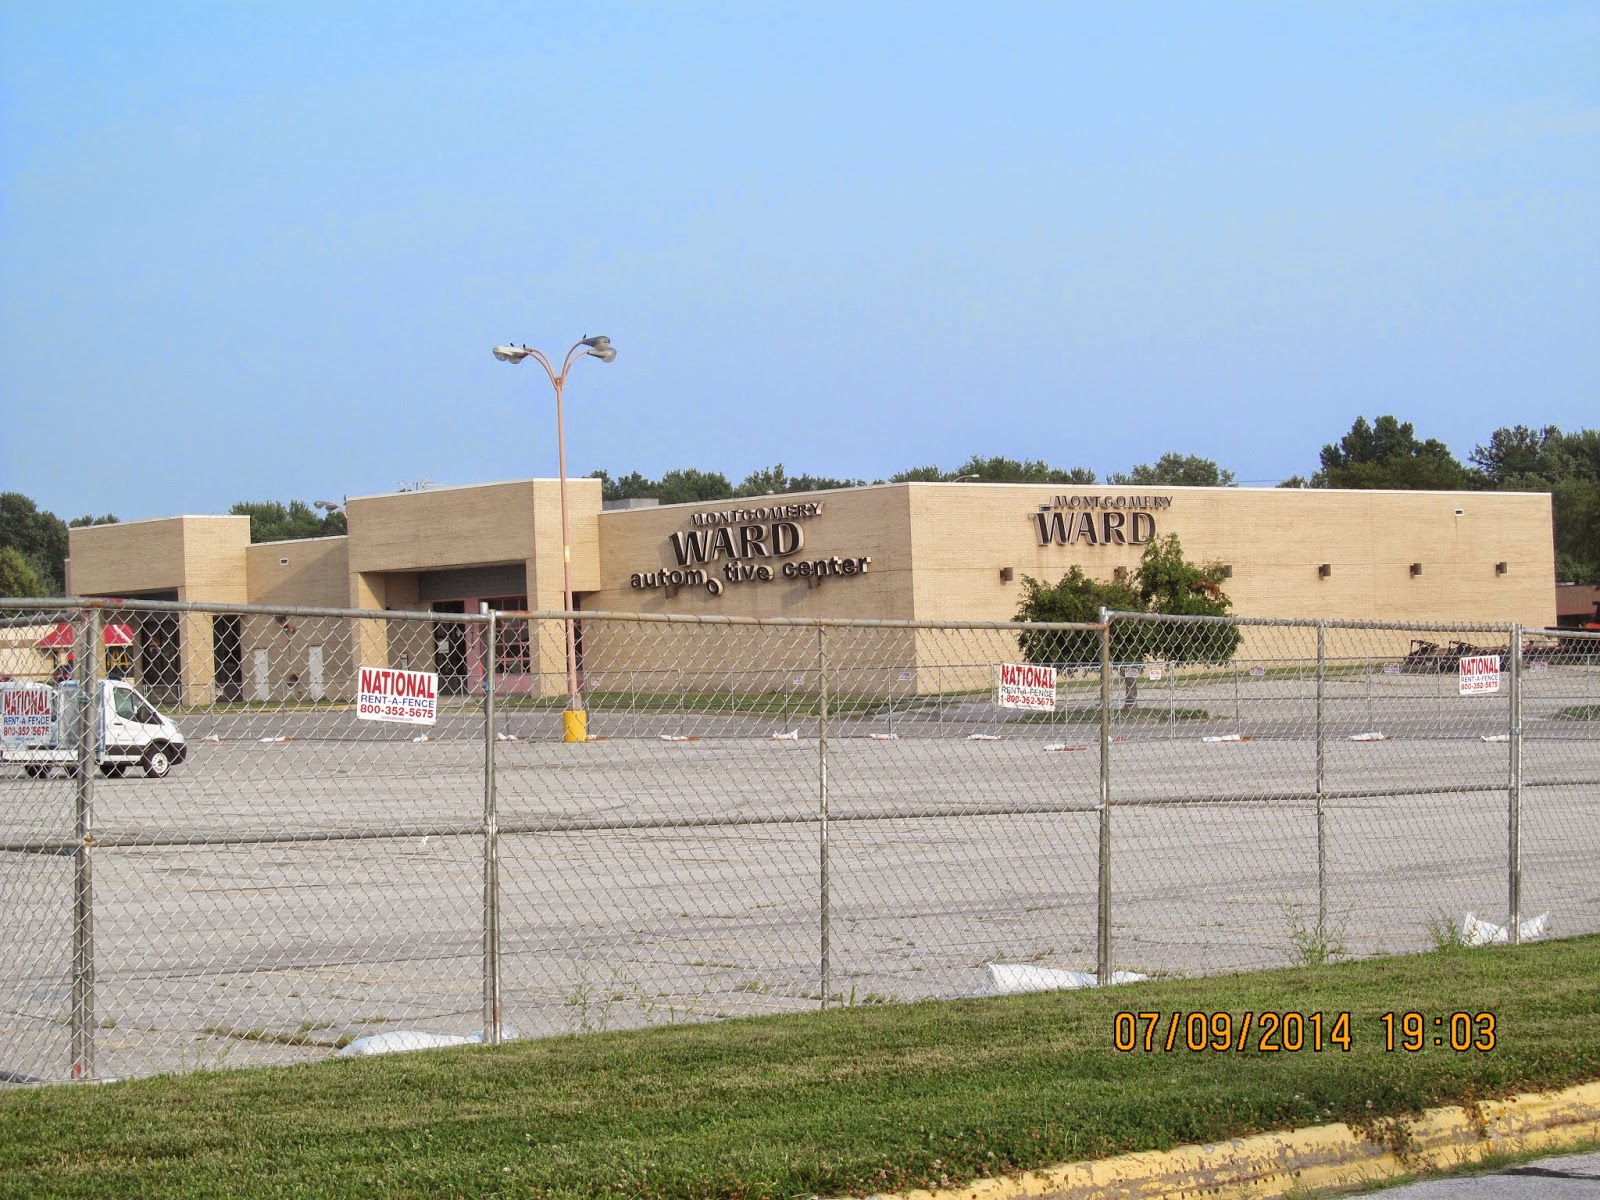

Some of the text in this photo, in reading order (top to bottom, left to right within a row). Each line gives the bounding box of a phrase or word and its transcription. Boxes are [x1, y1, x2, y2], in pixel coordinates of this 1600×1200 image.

[689, 501, 825, 526] MONTGOMERY
[1050, 495, 1173, 510] MONTGOMERY
[1027, 511, 1156, 546] WARD
[668, 521, 805, 567] WARD
[782, 555, 872, 577] center
[1001, 664, 1055, 689] NATIONAL
[1461, 656, 1499, 676] NATIONAL
[361, 669, 435, 699] NATIONAL
[1461, 674, 1498, 683] RENT-A-FENCE
[361, 694, 435, 708] RENT-A-FENCE
[1001, 685, 1054, 698] RENT-A-FENCE
[3, 690, 50, 716] NATIONAL
[360, 704, 434, 718] 800-352-5675
